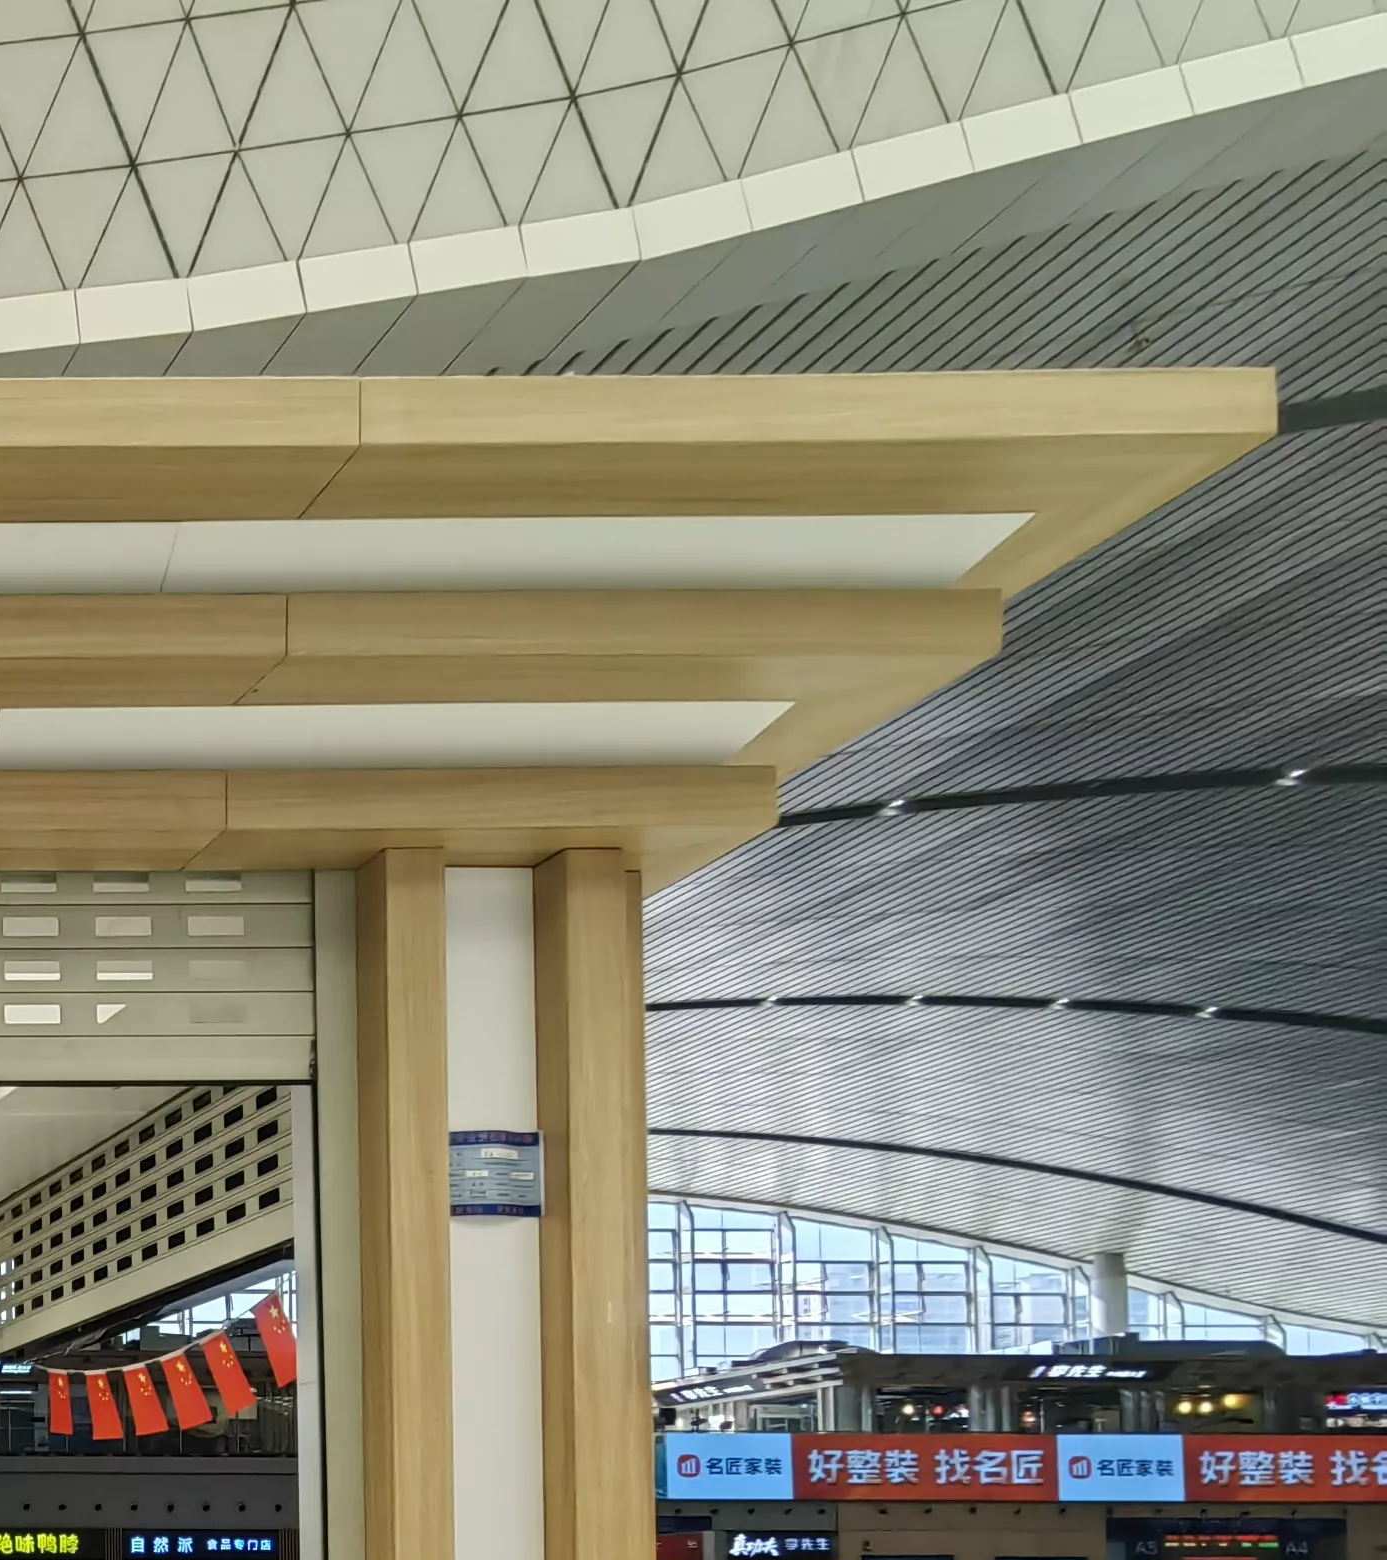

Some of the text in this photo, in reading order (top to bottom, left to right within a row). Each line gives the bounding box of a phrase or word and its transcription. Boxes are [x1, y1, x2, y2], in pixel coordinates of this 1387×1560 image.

[706, 1449, 1045, 1486] 名匠家装 好整装 找名匠
[1097, 1459, 1174, 1477] 名匠家装
[1200, 1450, 1315, 1486] 好整装
[130, 1536, 272, 1554] 自然派 食品专门店
